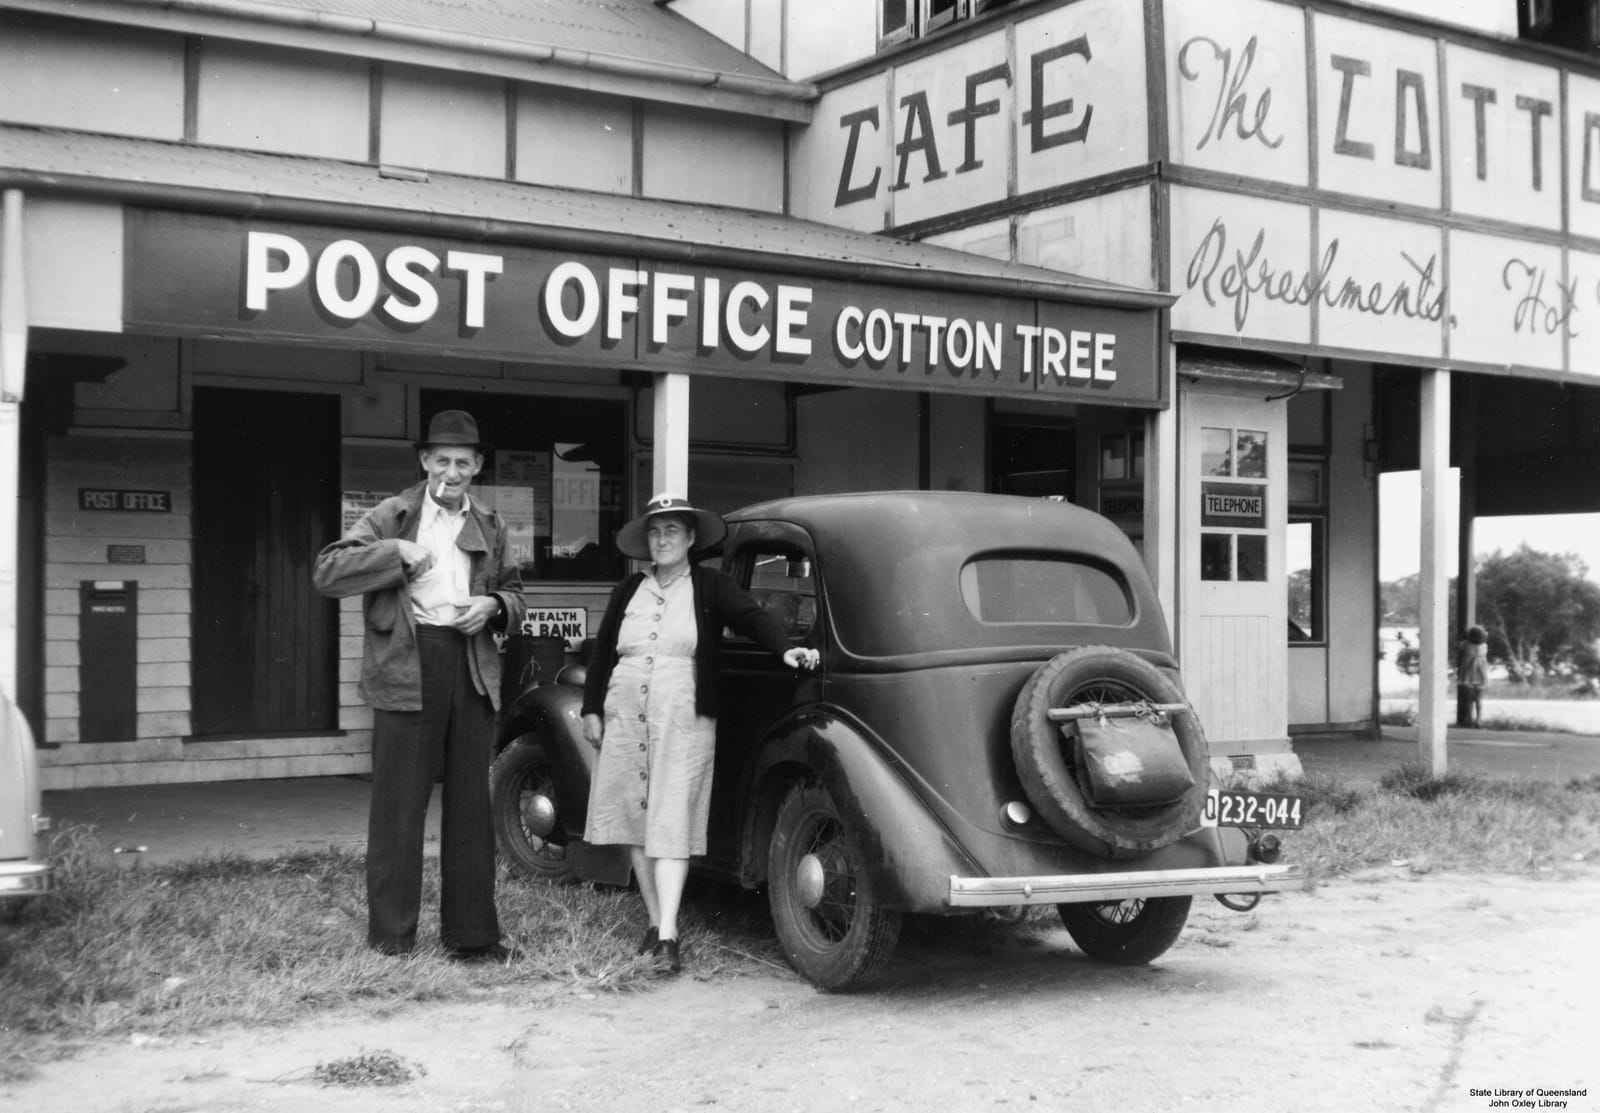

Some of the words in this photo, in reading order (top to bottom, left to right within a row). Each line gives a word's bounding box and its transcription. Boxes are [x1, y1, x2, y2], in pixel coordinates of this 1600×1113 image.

[1177, 35, 1284, 151] The
[834, 32, 1093, 208] CAFE
[246, 231, 504, 328] POST
[544, 261, 813, 355] OFFICE
[836, 306, 1002, 371] COTTON
[1016, 325, 1117, 381] TREE
[1503, 258, 1579, 338] Hot
[84, 491, 118, 509] POST
[124, 492, 167, 511] OFFICE
[1208, 497, 1260, 514] TELEPHONE
[525, 612, 577, 621] WEALTH
[540, 623, 583, 637] BANK
[1221, 795, 1301, 826] 232-044
